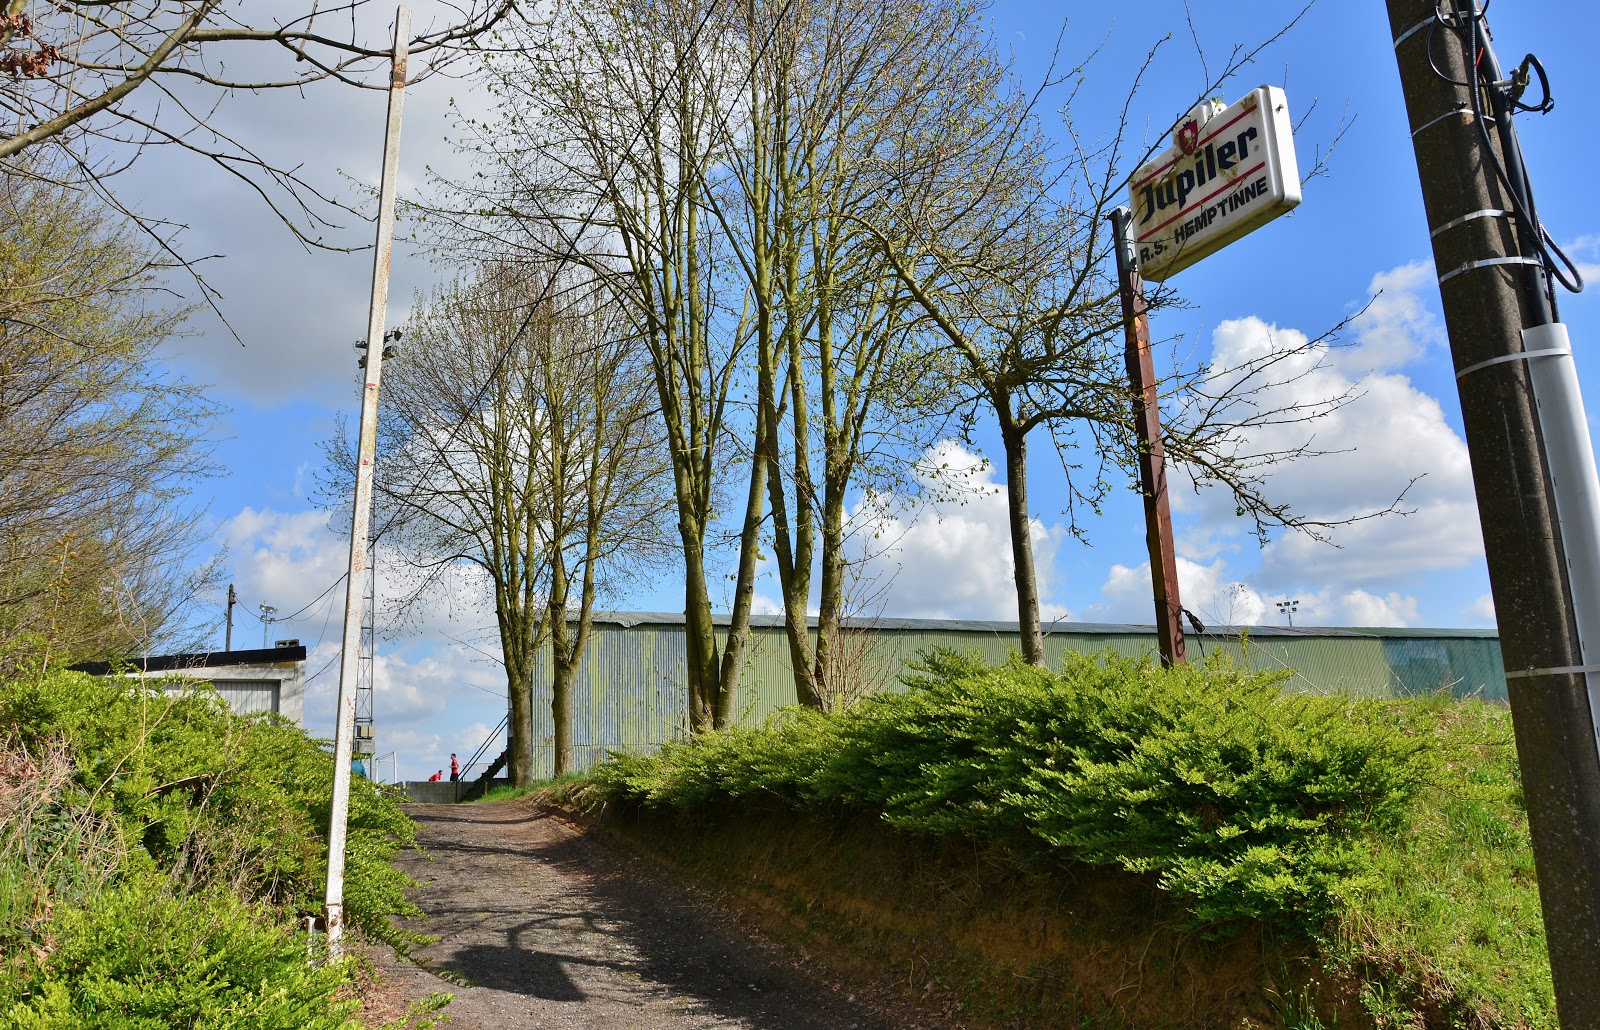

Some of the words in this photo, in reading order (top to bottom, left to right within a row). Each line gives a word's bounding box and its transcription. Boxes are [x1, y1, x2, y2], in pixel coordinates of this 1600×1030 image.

[1138, 126, 1258, 226] Jupiler
[1139, 241, 1168, 264] R.S.
[1174, 176, 1268, 244] HEMPTINNE
